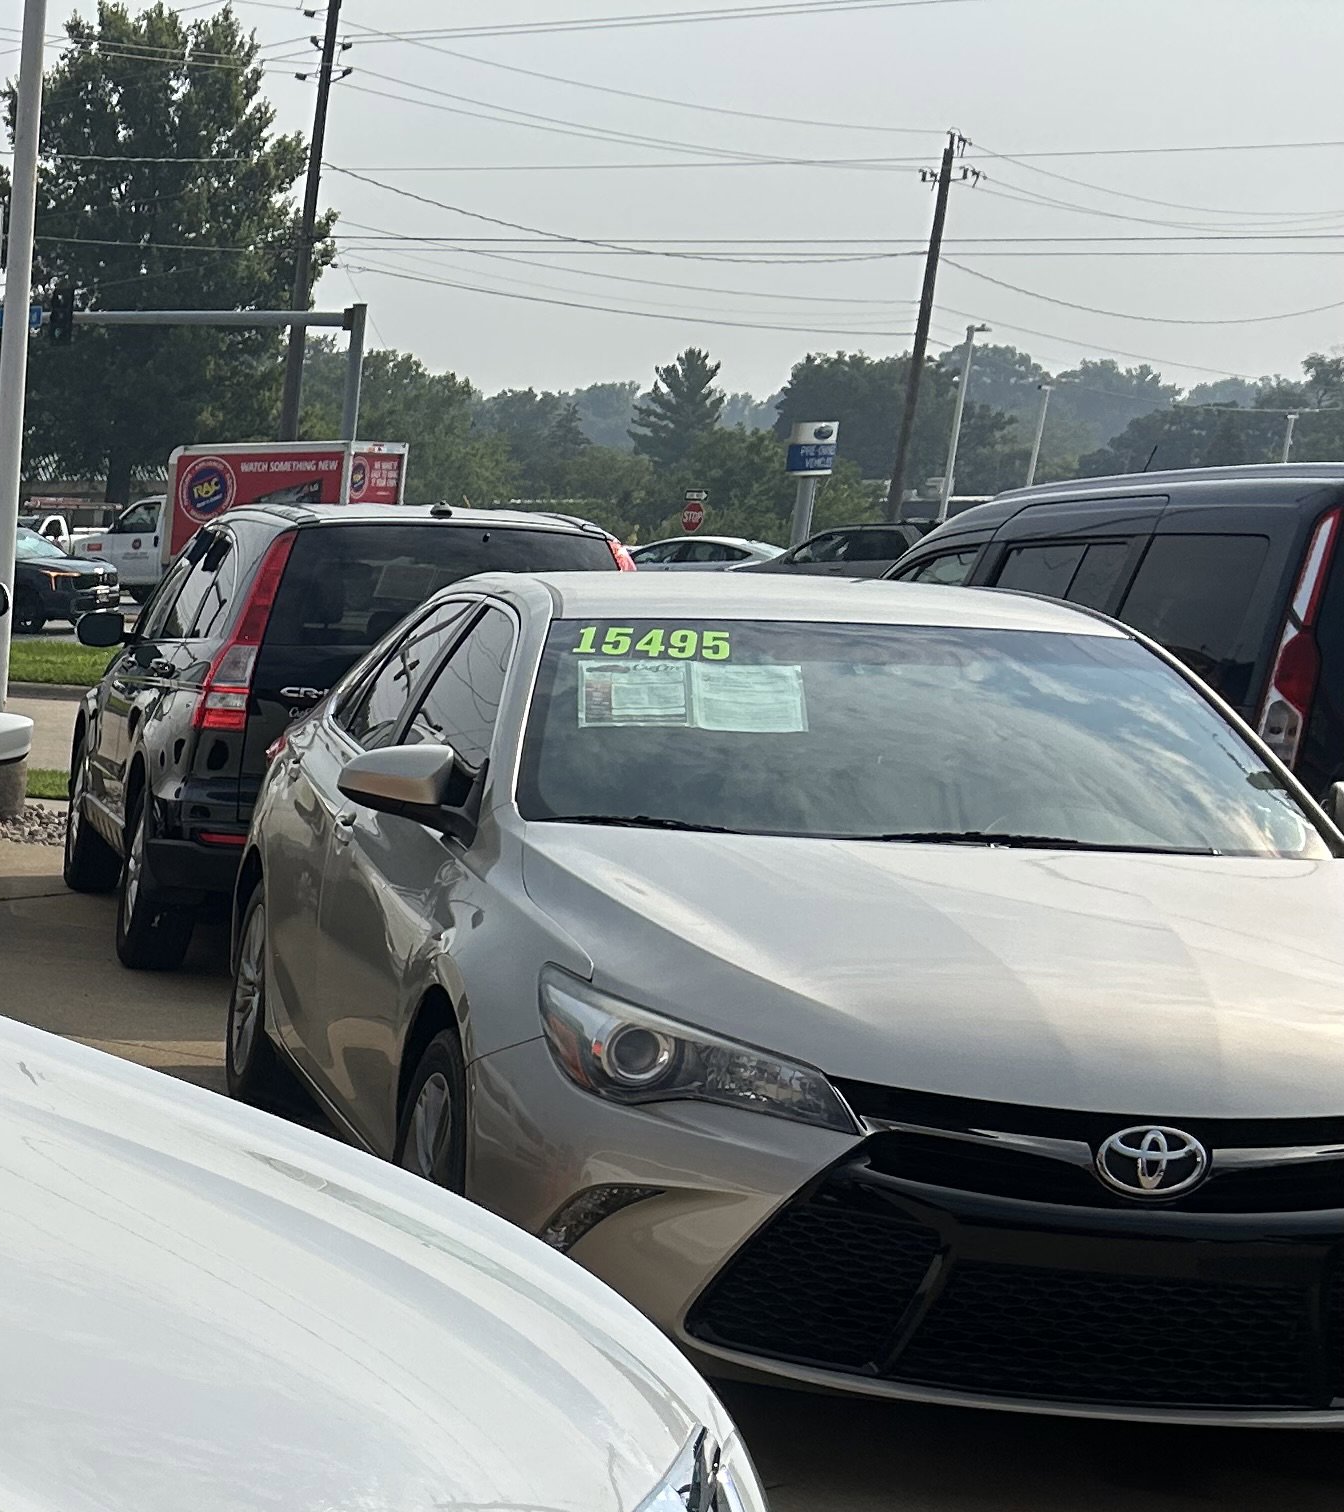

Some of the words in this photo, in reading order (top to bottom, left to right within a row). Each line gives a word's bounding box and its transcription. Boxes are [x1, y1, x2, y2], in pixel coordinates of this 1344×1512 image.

[240, 461, 268, 473] WATCH
[269, 460, 317, 472] SOMETHING
[318, 459, 339, 471] NEW
[682, 511, 703, 523] STOP
[572, 626, 731, 660] 15495
